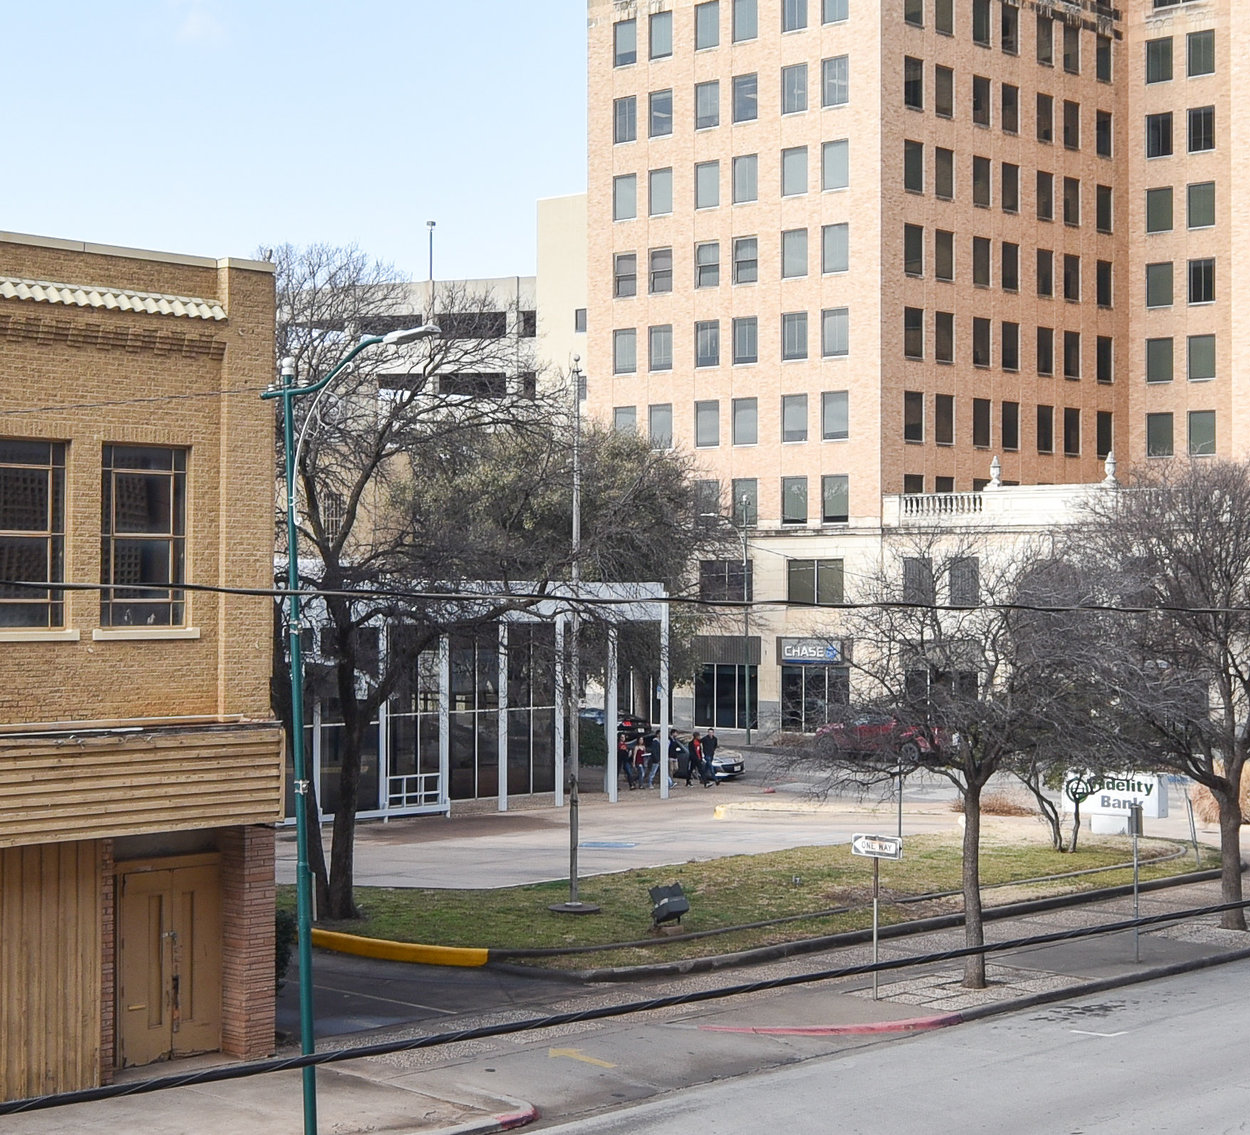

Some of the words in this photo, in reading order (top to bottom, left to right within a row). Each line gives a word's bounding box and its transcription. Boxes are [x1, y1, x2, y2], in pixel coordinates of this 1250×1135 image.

[784, 645, 824, 657] CHASE
[1101, 795, 1144, 810] Bank
[861, 841, 875, 850] ONE
[878, 842, 893, 852] WAY
